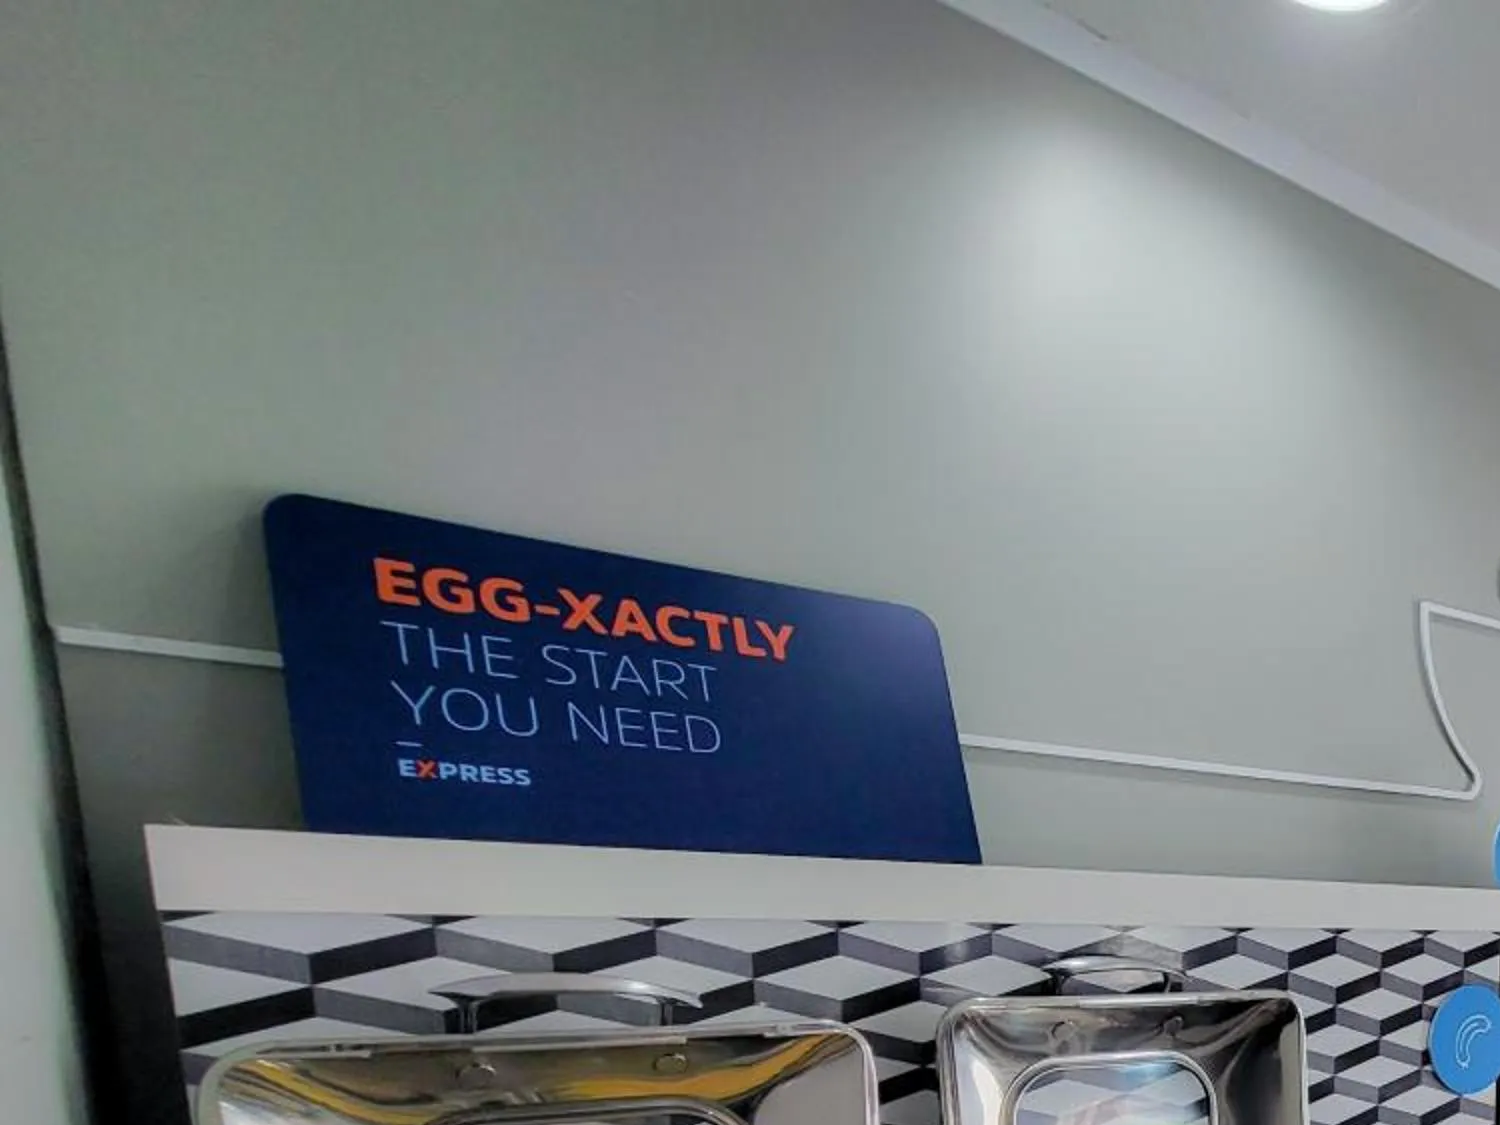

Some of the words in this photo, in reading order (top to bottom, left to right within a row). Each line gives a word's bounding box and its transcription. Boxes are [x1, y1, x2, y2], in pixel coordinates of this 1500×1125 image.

[373, 557, 794, 663] EGG-XACTLY
[381, 620, 515, 680] THE
[541, 645, 718, 703] START
[391, 681, 539, 738] YOU
[569, 704, 721, 754] NEED
[399, 758, 531, 787] EXPRESS
